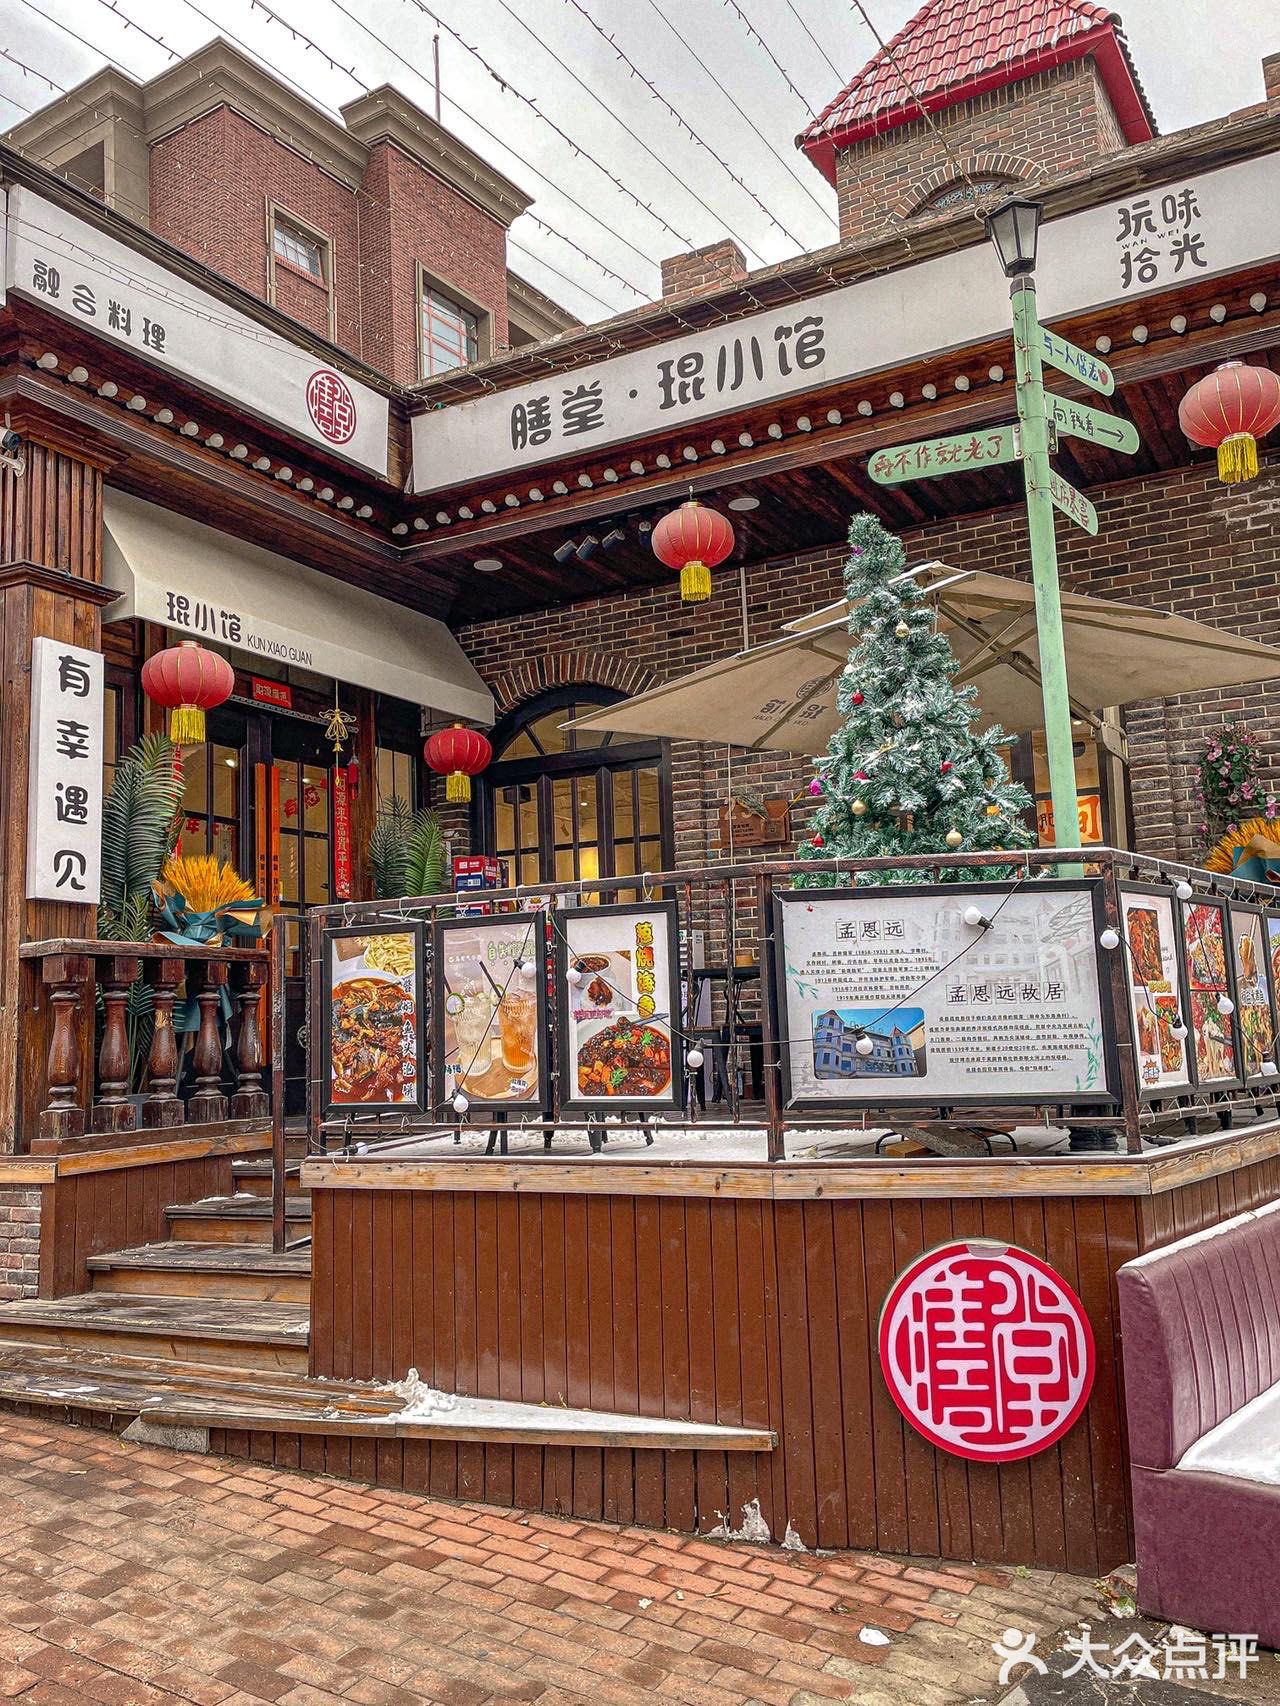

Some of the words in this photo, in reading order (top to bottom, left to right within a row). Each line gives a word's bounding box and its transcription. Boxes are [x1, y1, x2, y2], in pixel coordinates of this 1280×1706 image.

[1116, 188, 1202, 242] 玩味
[1120, 233, 1208, 289] 拾光
[1121, 238, 1148, 250] WAN
[1157, 228, 1180, 239] WEI
[32, 258, 167, 354] 融合料理
[1053, 399, 1094, 437] 向钱看
[166, 591, 242, 643] 琨小馆
[247, 633, 268, 653] KUN
[268, 639, 288, 658] XIAO
[288, 647, 313, 666] GUAN
[53, 654, 92, 892] 有幸遇见
[836, 920, 905, 941] 孟恩远
[946, 982, 1066, 1006] 孟恩远故居
